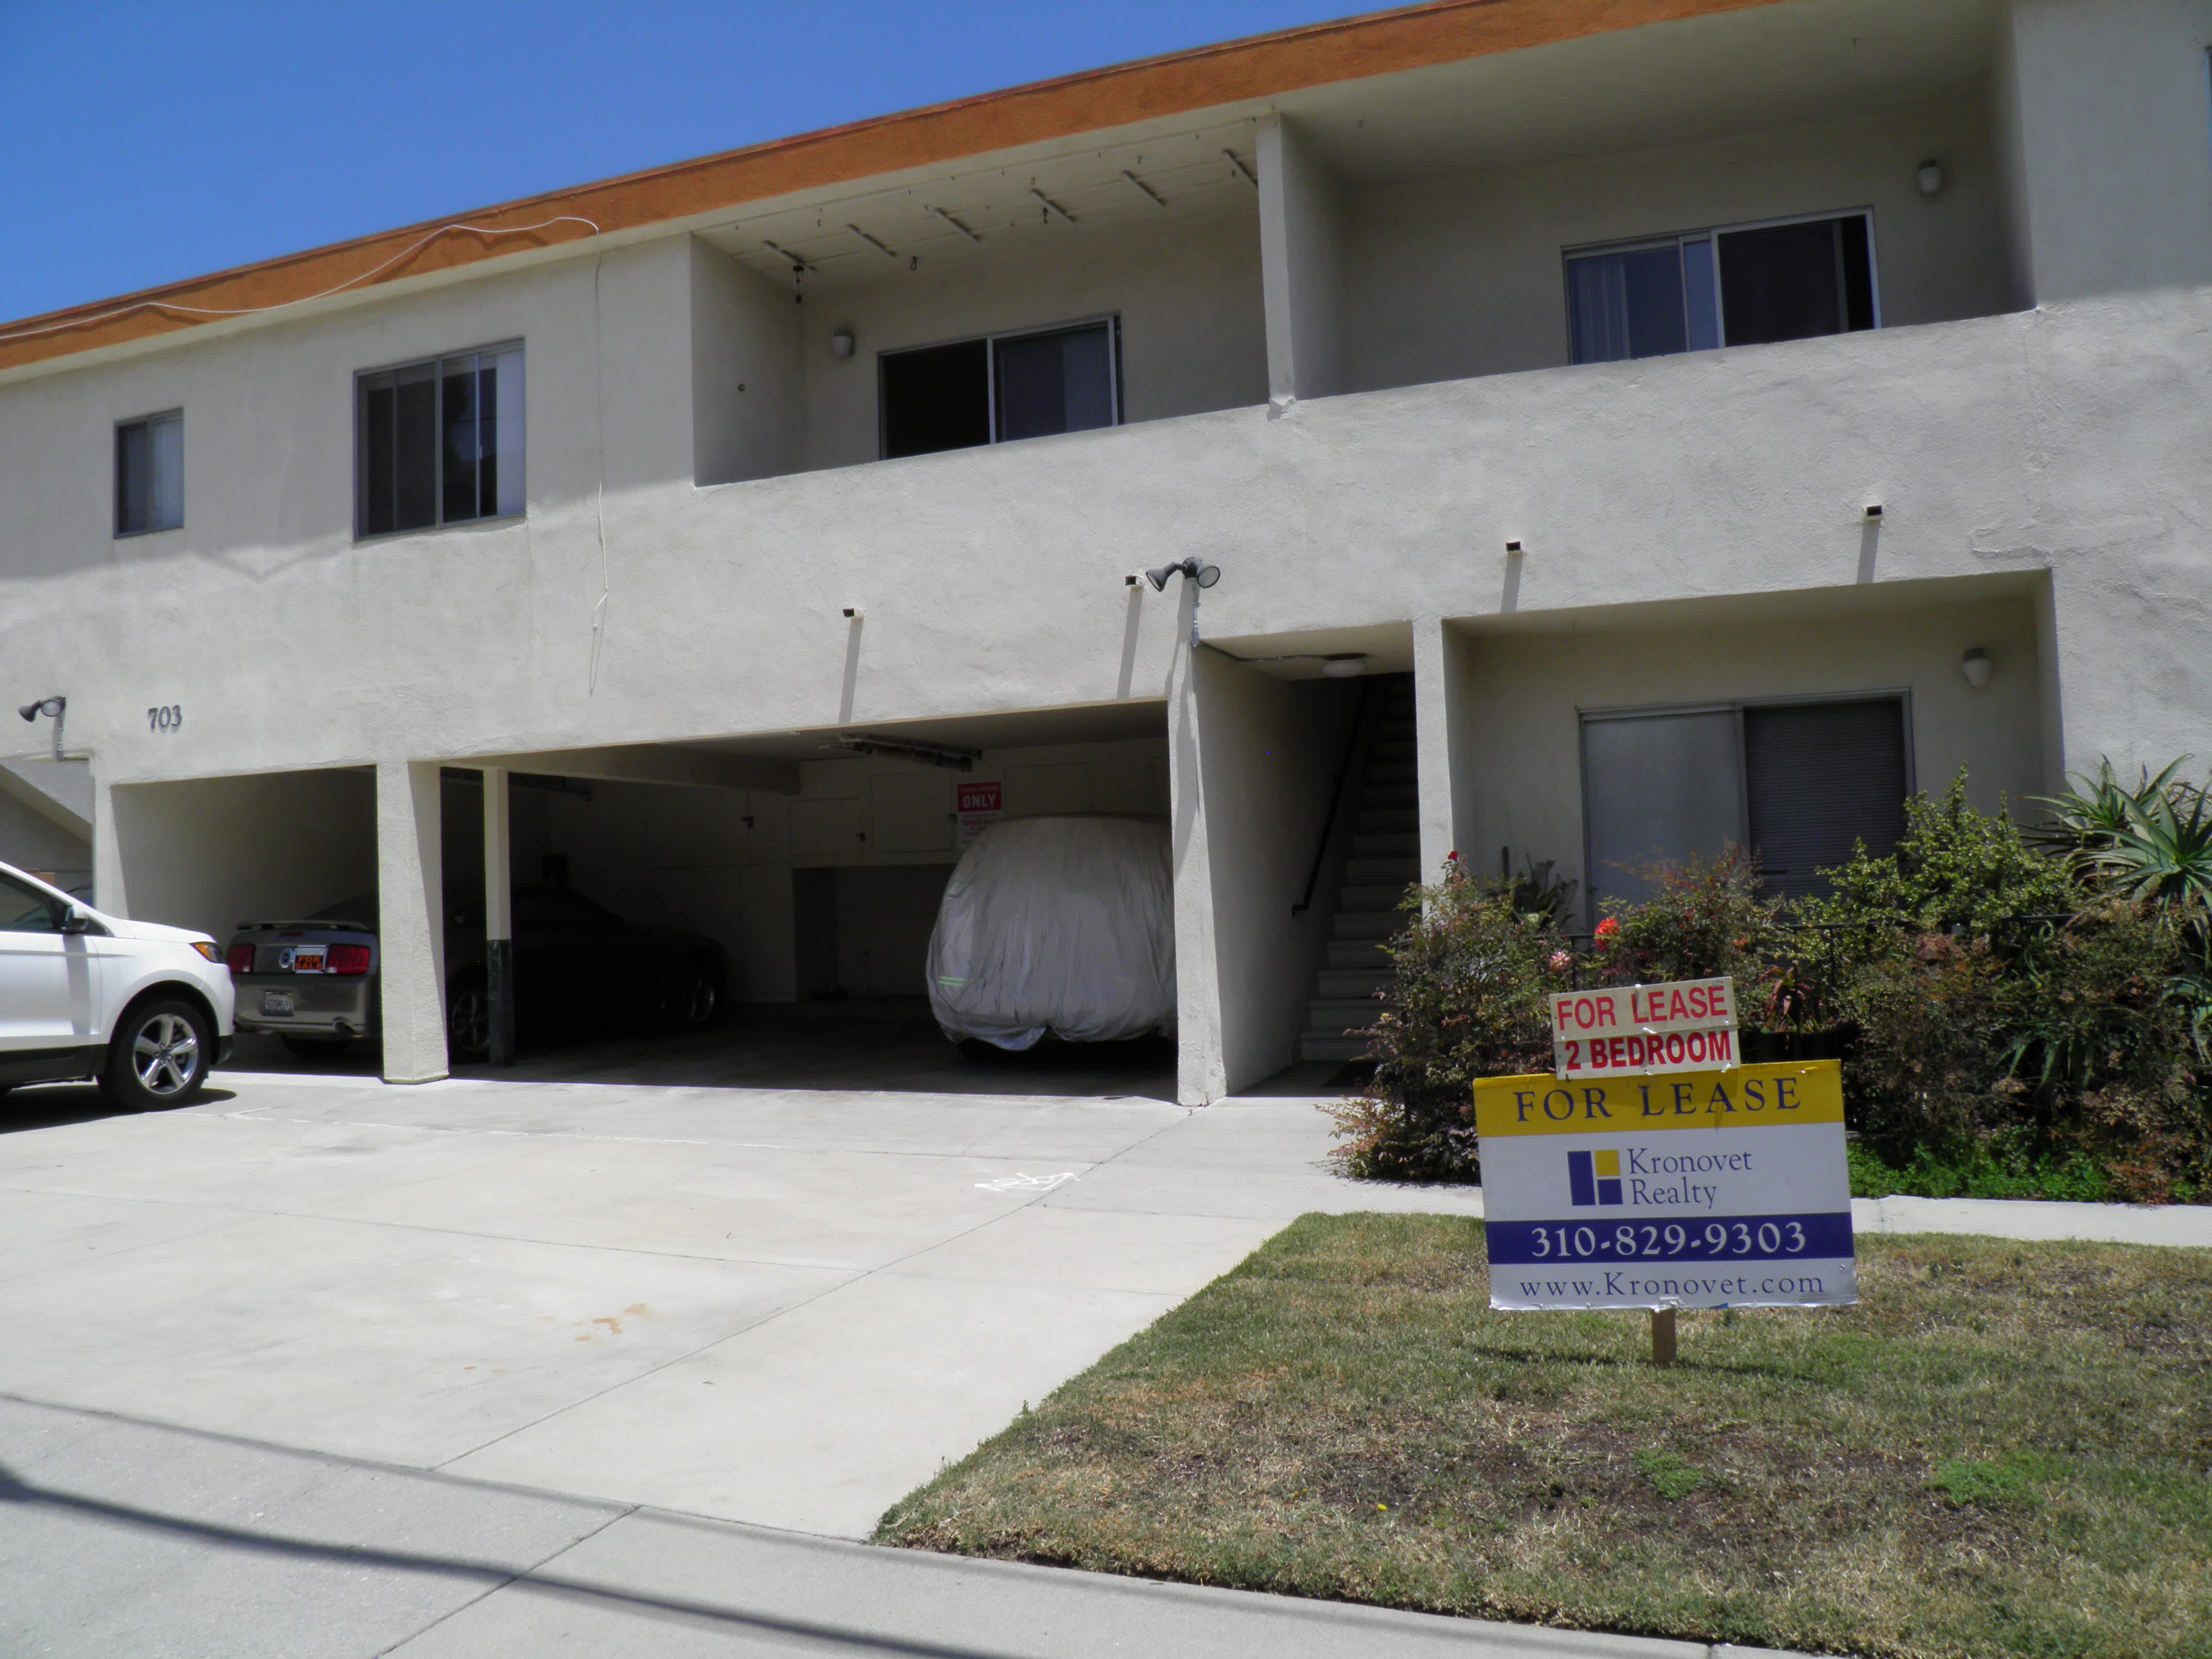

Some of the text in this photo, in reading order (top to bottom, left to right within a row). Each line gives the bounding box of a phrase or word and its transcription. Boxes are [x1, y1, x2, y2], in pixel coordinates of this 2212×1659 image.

[148, 705, 183, 730] 703
[963, 793, 997, 808] ONLY
[1557, 985, 1728, 1031] FOR LEASE
[1565, 1030, 1732, 1071] 2 BEDROOM
[1513, 1077, 1802, 1123] FOR LEASE
[1627, 1148, 1753, 1175] Kronovet
[1631, 1177, 1717, 1209] Realty
[1532, 1221, 1806, 1257] 310-829-9303
[1519, 1272, 1824, 1297] www.Kronovet.com
